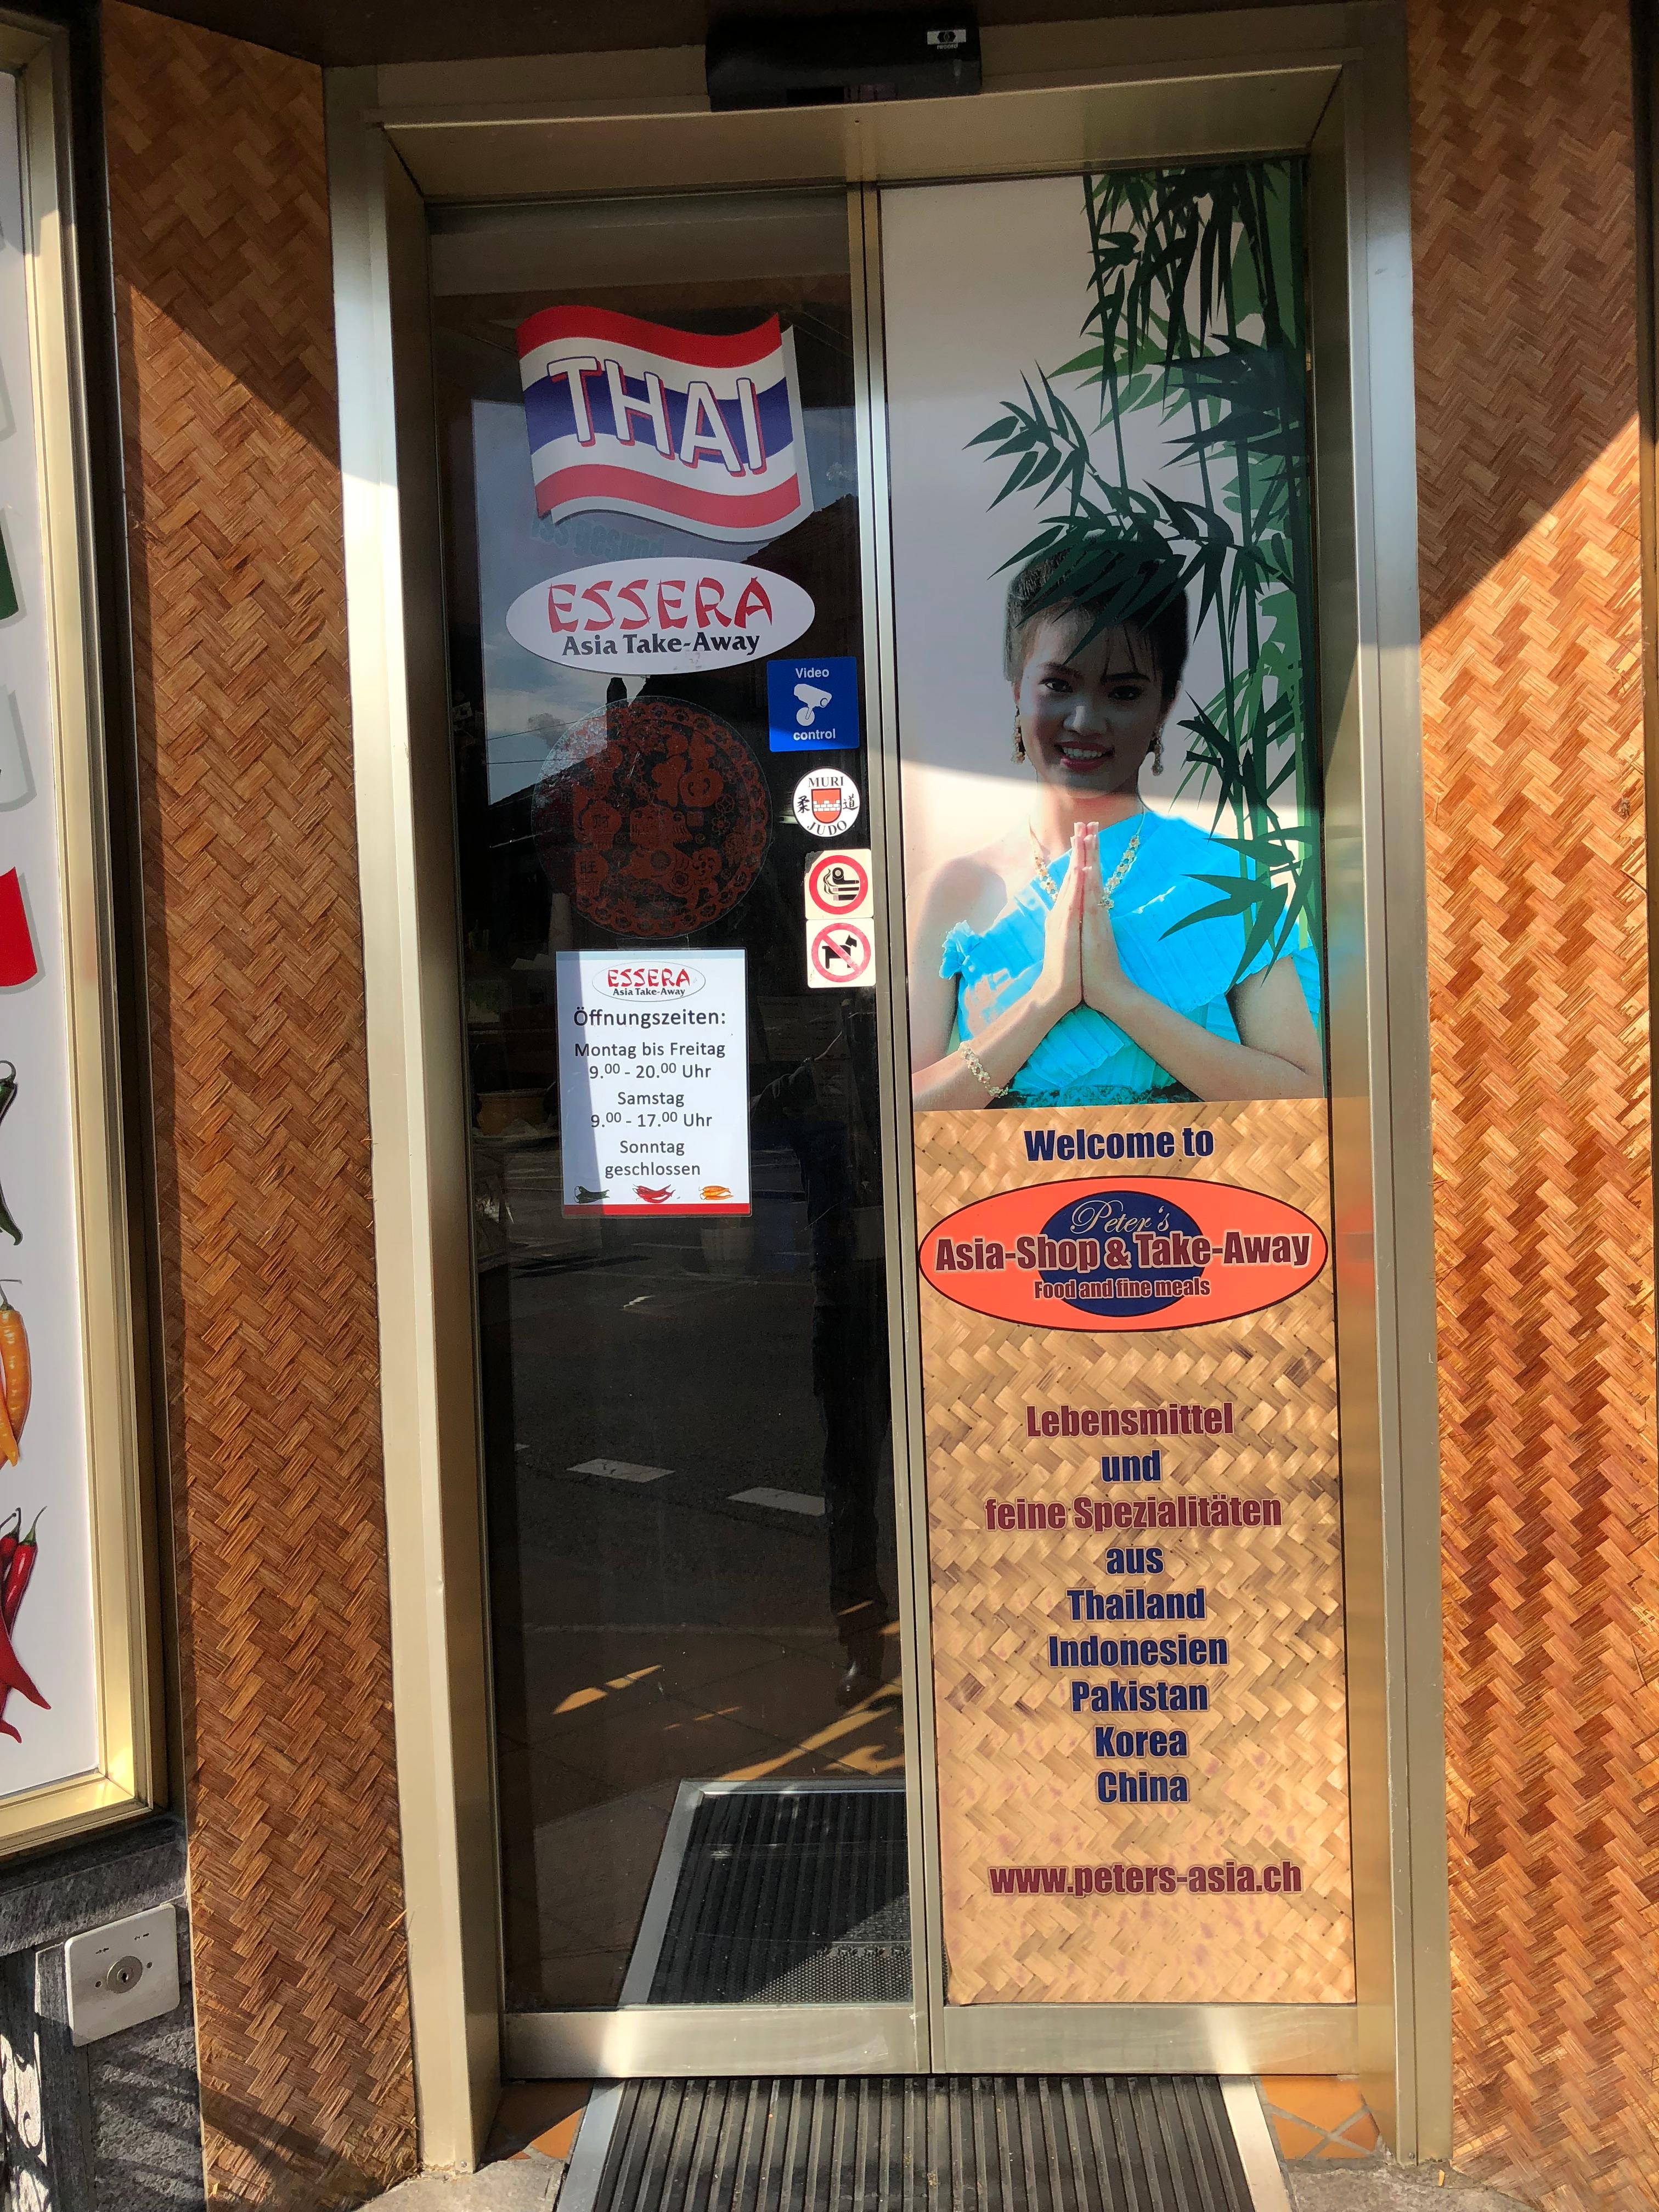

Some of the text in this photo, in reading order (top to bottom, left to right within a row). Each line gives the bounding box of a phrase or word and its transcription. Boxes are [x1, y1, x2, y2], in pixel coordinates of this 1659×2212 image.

[547, 356, 766, 477] THAI
[548, 576, 772, 632] ESSERA
[562, 631, 760, 656] Asia Take-Away
[795, 667, 830, 679] Video
[793, 728, 836, 741] control
[808, 776, 845, 787] MURI
[797, 795, 810, 813] 柔
[843, 793, 859, 811] 道
[807, 820, 847, 836] JUDO
[607, 968, 691, 988] ESSERA
[635, 988, 685, 997] Take-Away
[574, 1007, 725, 1028] Öffnungszeiten:
[575, 1042, 725, 1058] Montag bis Freitag
[682, 1064, 711, 1077] Uhr
[618, 1092, 684, 1107] Samstag
[684, 1113, 712, 1127] Uhr
[620, 1141, 685, 1155] Sonntag
[1024, 1127, 1214, 1161] Welcome to
[605, 1163, 701, 1179] geschlossen
[935, 1231, 1312, 1273] Asia-Shop & Take-Away
[1035, 1277, 1210, 1299] Food and fine meals
[1026, 1403, 1233, 1438] Lebensmittel
[1102, 1449, 1161, 1483] und
[985, 1495, 1283, 1532] feine Spezialitäten
[1106, 1545, 1165, 1575] aus
[1066, 1588, 1205, 1622] Thailand
[1048, 1635, 1228, 1667] Indonesien
[1071, 1681, 1209, 1713] Pakistan
[1095, 1726, 1188, 1758] Korea
[1098, 1770, 1189, 1804] China
[990, 1861, 1302, 1897] www.peters-asia.ch
